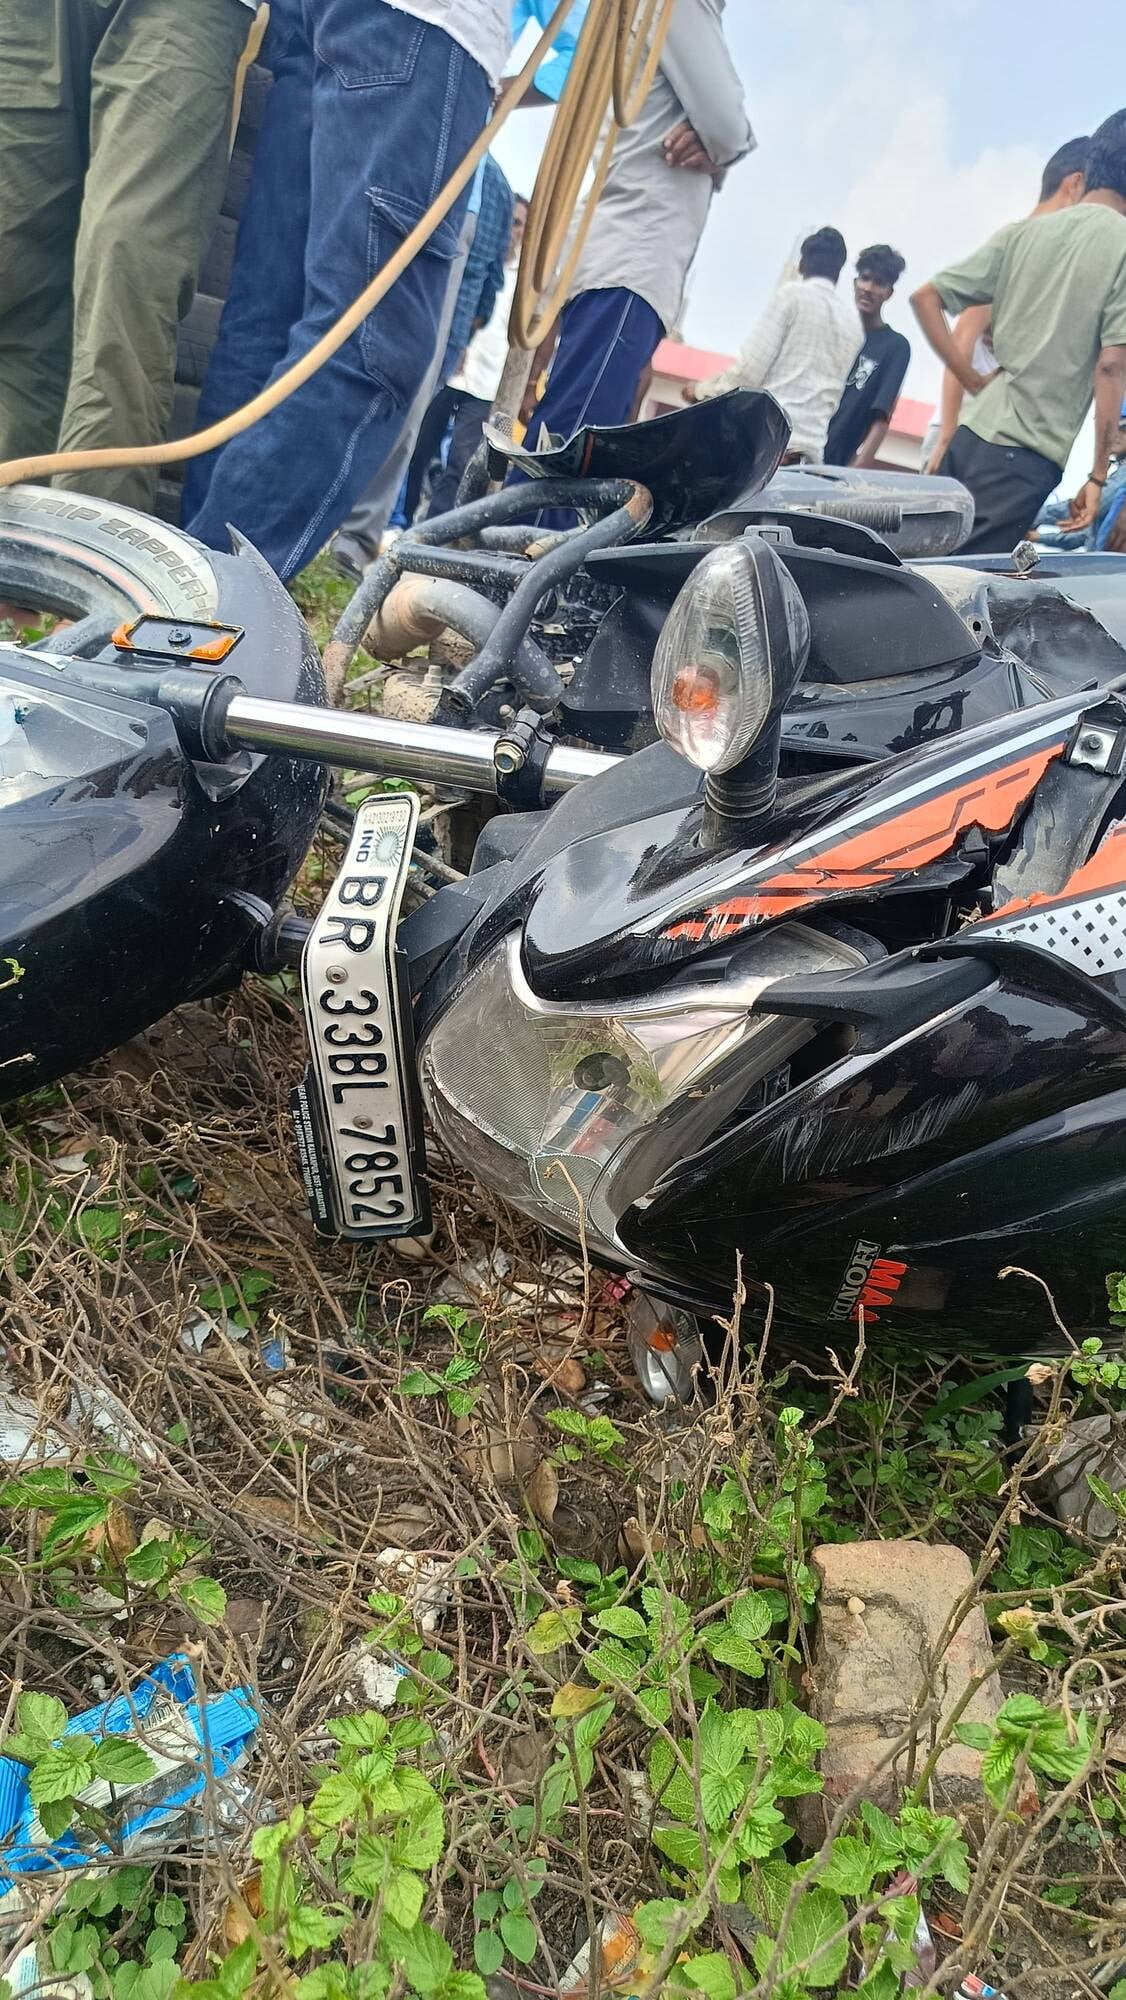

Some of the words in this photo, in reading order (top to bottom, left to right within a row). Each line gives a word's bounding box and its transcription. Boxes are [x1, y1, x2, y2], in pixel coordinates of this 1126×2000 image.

[6, 493, 103, 522] GRIP
[356, 830, 374, 862] IND
[319, 876, 388, 952] BR
[319, 989, 389, 1104] 33BL
[300, 1099, 311, 1120] POLICE
[303, 1120, 314, 1143] STATION
[339, 1124, 405, 1221] 7852
[826, 1242, 880, 1321] HONDA
